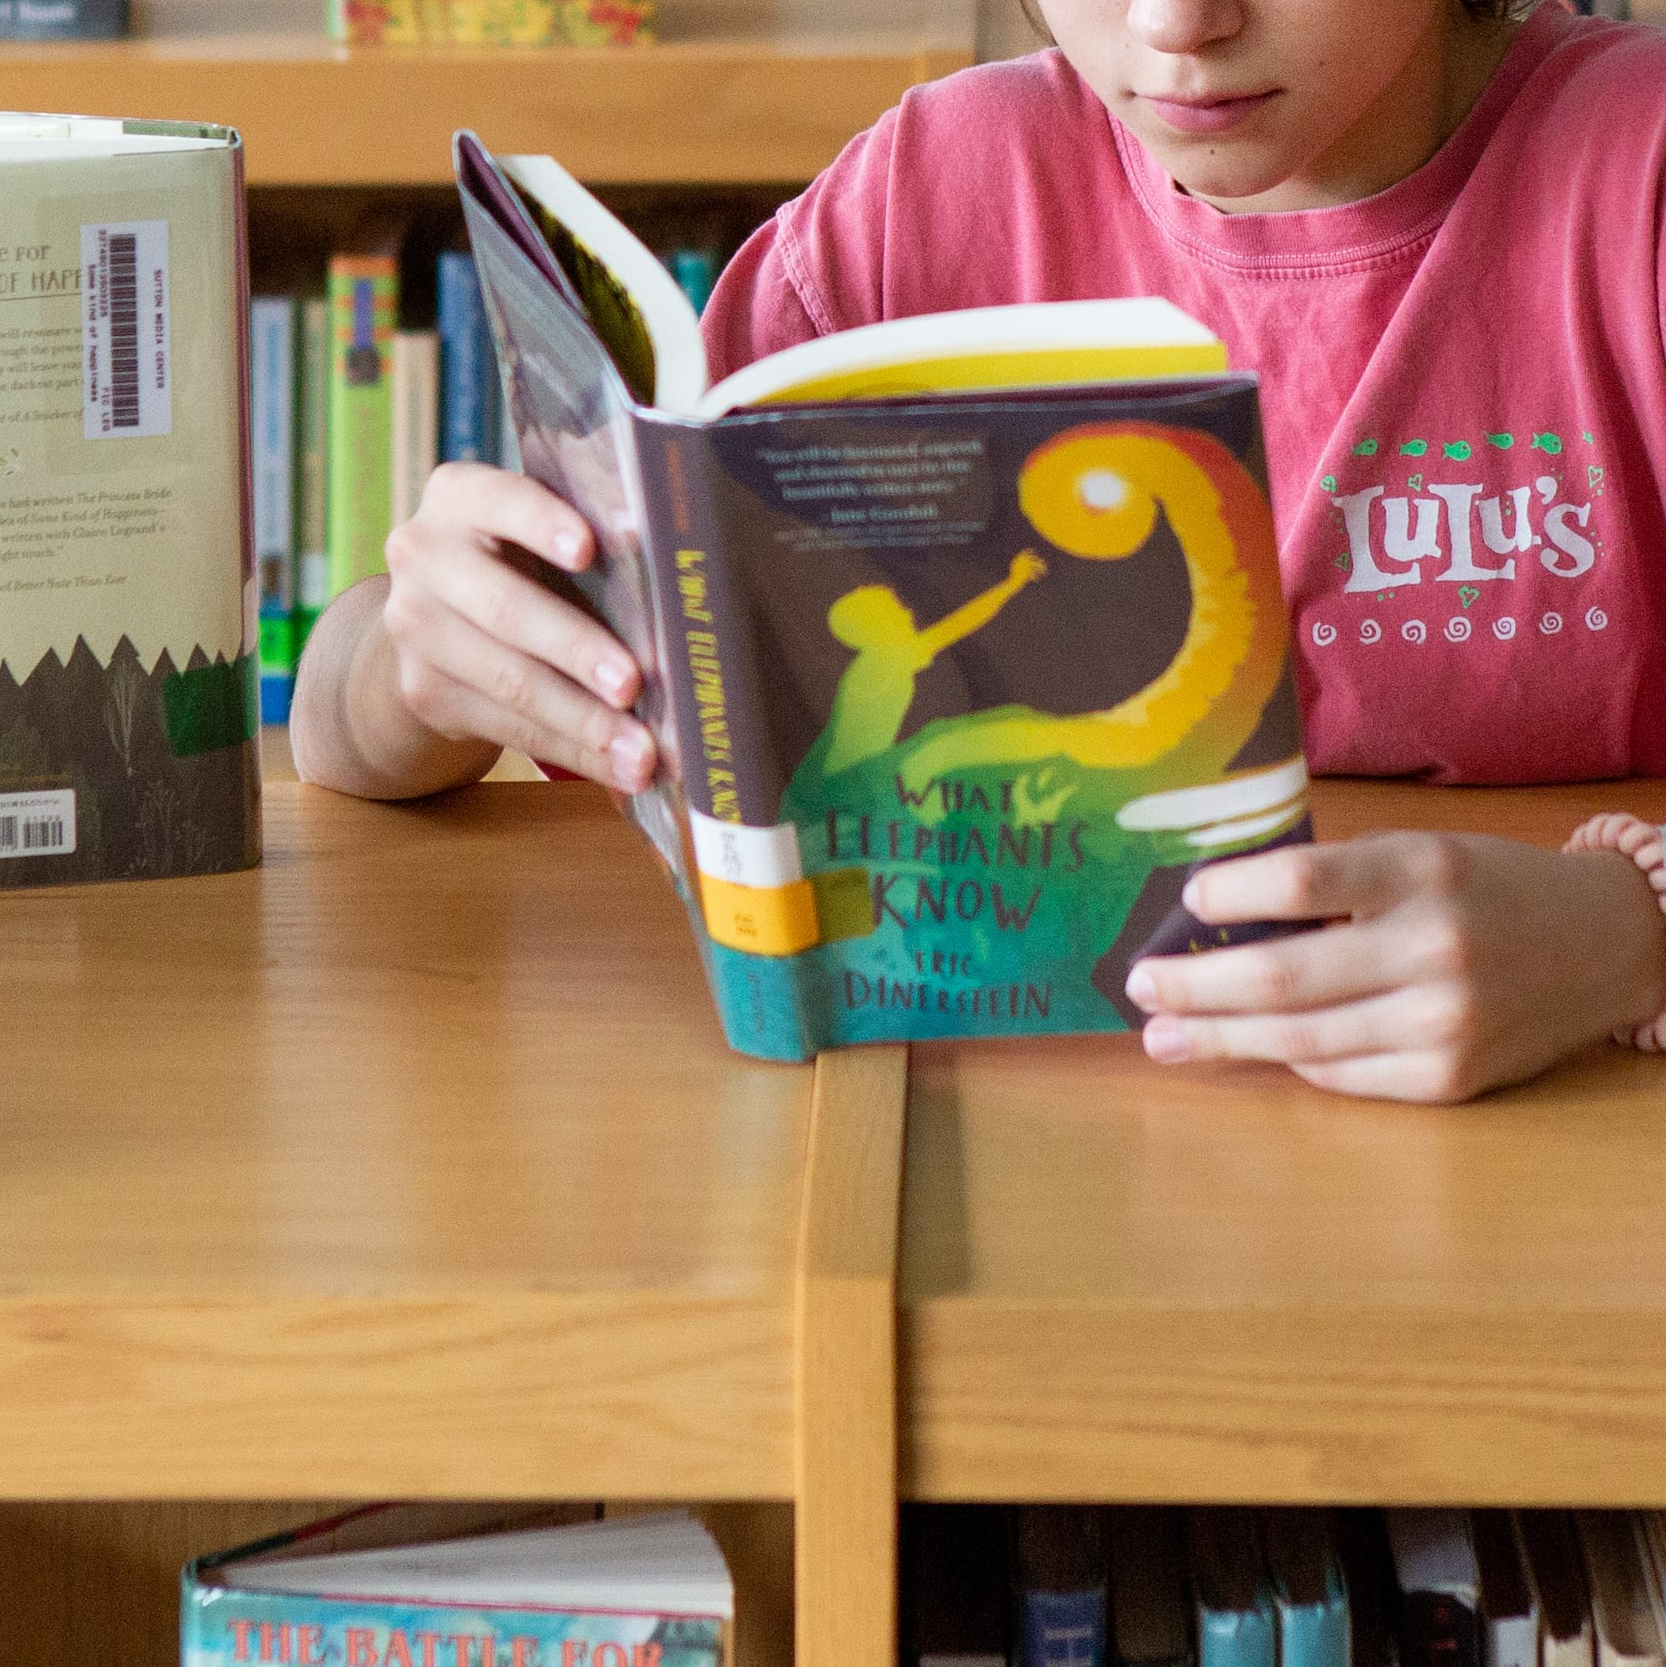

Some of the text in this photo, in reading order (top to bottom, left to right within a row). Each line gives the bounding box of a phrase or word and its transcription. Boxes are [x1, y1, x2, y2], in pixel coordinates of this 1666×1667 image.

[153, 268, 166, 390] SUTTON MEDIA CENTER
[1332, 476, 1596, 593] LuLu's
[893, 770, 1015, 818] WHAT
[826, 806, 1089, 874] ELEPHANTS
[872, 875, 1043, 933] KNOW
[913, 946, 975, 979] ERIC
[843, 970, 1052, 1020] DINERSTEIN
[225, 1619, 665, 1667] THE BATTLE FOR
